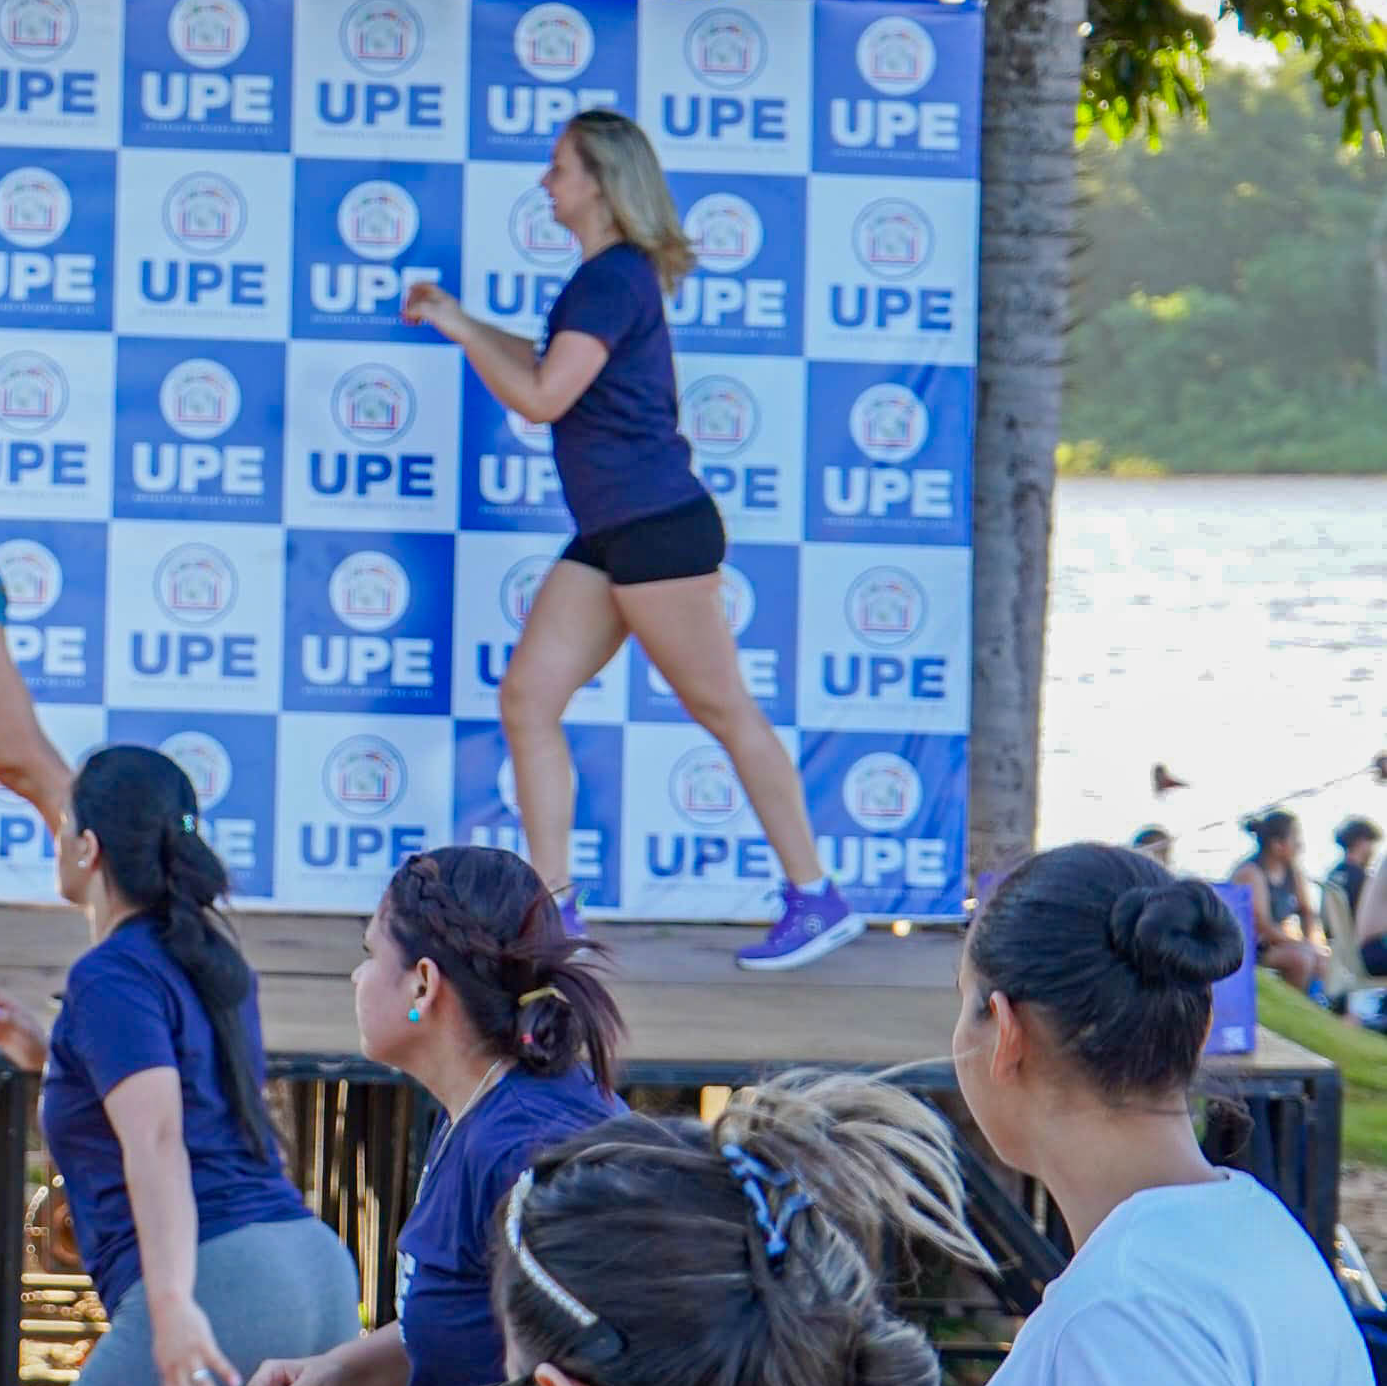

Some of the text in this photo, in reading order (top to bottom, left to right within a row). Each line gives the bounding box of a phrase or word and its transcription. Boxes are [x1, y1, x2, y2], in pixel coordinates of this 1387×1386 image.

[142, 72, 274, 123] UPE
[315, 82, 443, 128] UPE
[662, 95, 789, 142] UPE
[831, 100, 961, 152] UPE
[139, 260, 267, 308] UPE
[830, 284, 954, 332] UPE
[132, 444, 265, 495] UPE
[309, 452, 436, 498] UPE
[823, 467, 954, 519] UPE
[130, 632, 257, 679] UPE
[302, 634, 434, 687] UPE
[821, 654, 948, 700] UPE
[645, 834, 772, 879] UPE
[816, 835, 947, 889] UPE
